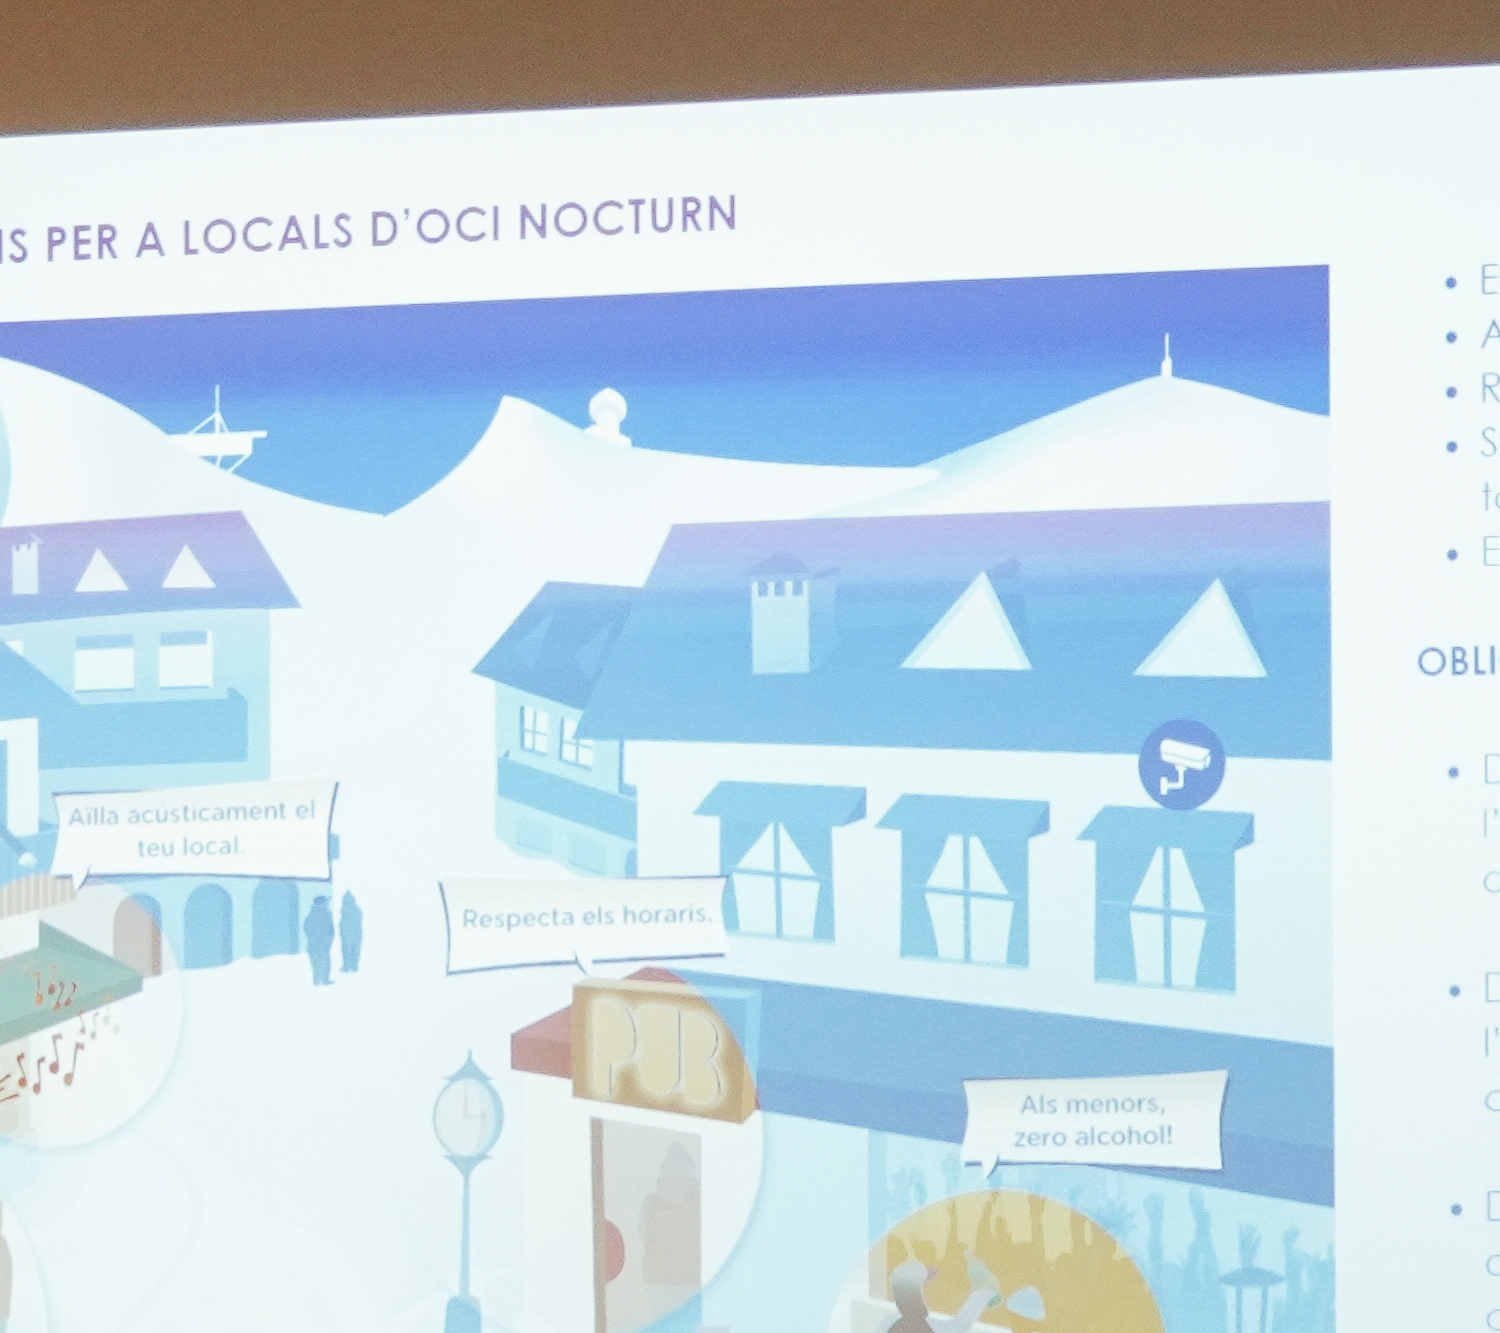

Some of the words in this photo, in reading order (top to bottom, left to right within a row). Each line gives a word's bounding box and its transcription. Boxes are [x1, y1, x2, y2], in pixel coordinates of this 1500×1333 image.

[47, 223, 119, 264] PER
[136, 221, 166, 260] A
[184, 212, 354, 258] LOCALS
[372, 205, 501, 249] D'OCI
[520, 194, 737, 242] NOCTURN
[67, 804, 121, 829] Aïlla
[126, 800, 288, 827] acústicament
[294, 798, 318, 822] el
[137, 840, 177, 861] teu
[182, 835, 246, 858] local.
[461, 905, 577, 935] Respecta
[582, 904, 616, 927] els
[621, 902, 714, 928] horaris.
[590, 997, 726, 1106] PUB
[1020, 1093, 1060, 1116] Als
[1066, 1096, 1168, 1117] menors,
[1013, 1131, 1069, 1151] zero
[1074, 1124, 1175, 1149] alcohol!
